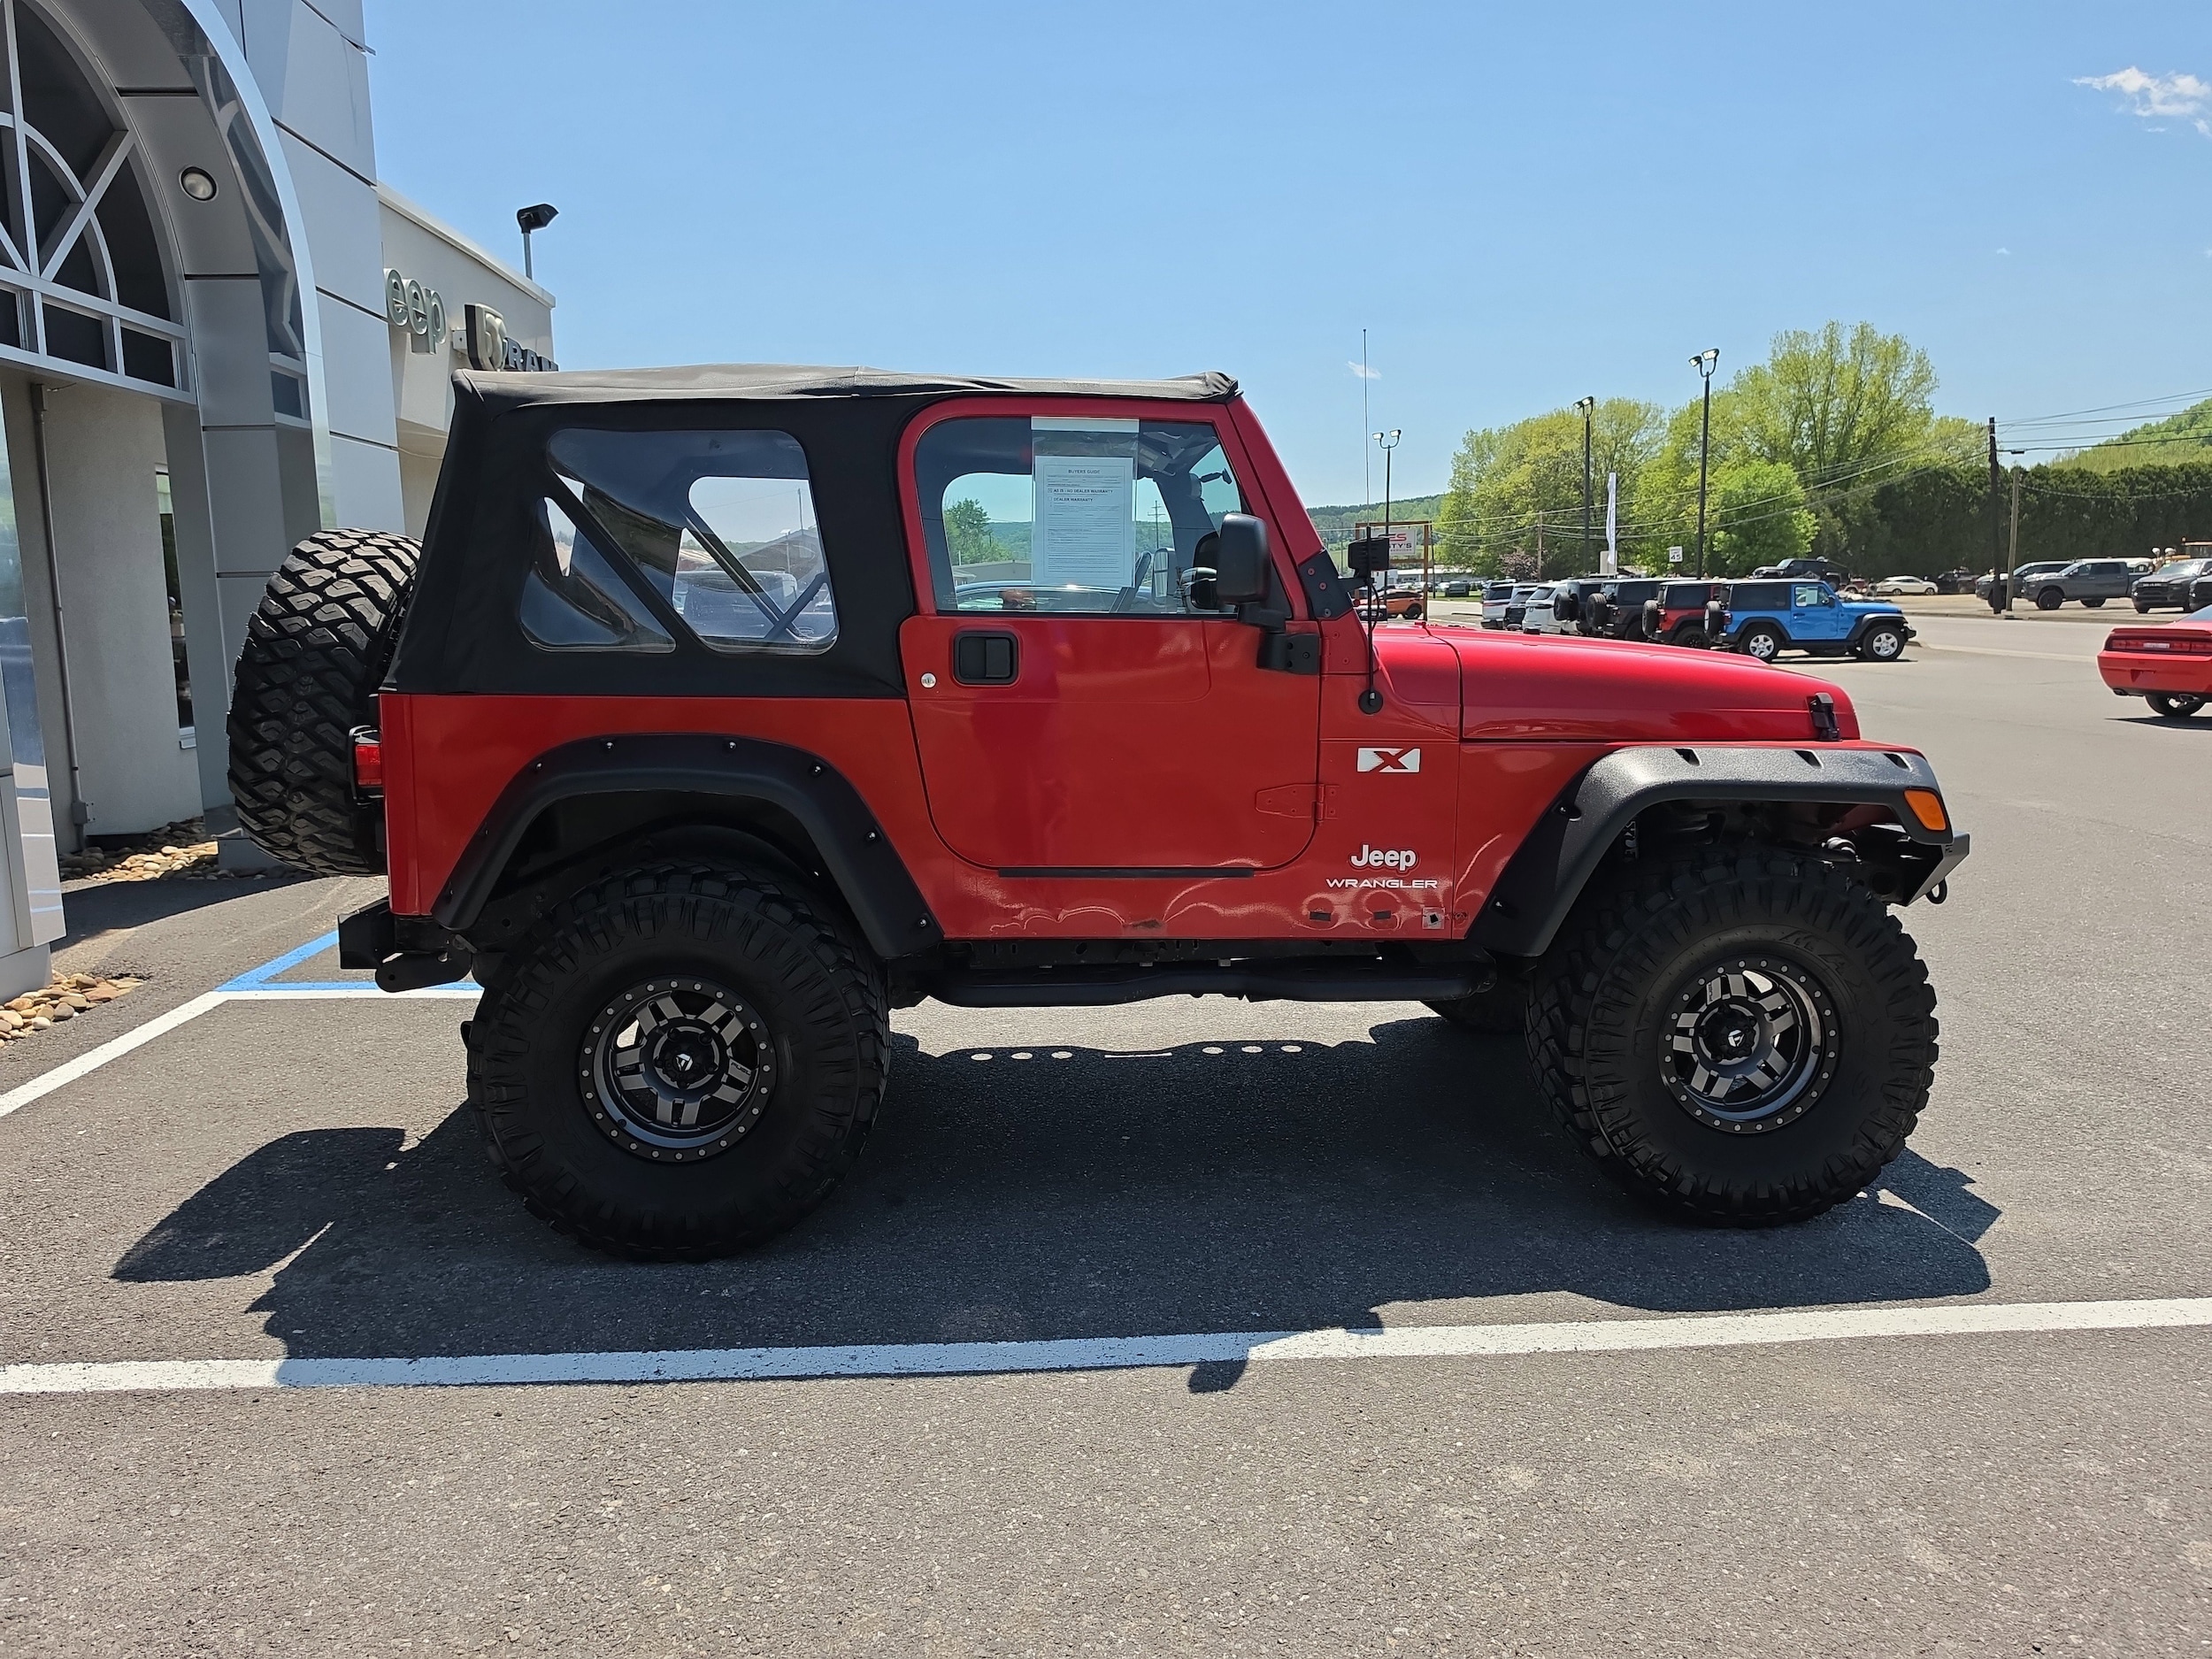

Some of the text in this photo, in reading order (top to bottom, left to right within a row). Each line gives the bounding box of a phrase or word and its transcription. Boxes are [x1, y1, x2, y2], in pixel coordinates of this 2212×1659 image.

[383, 268, 447, 354] eep
[1351, 844, 1417, 872] Jeep
[1325, 879, 1439, 888] WRANGLER
